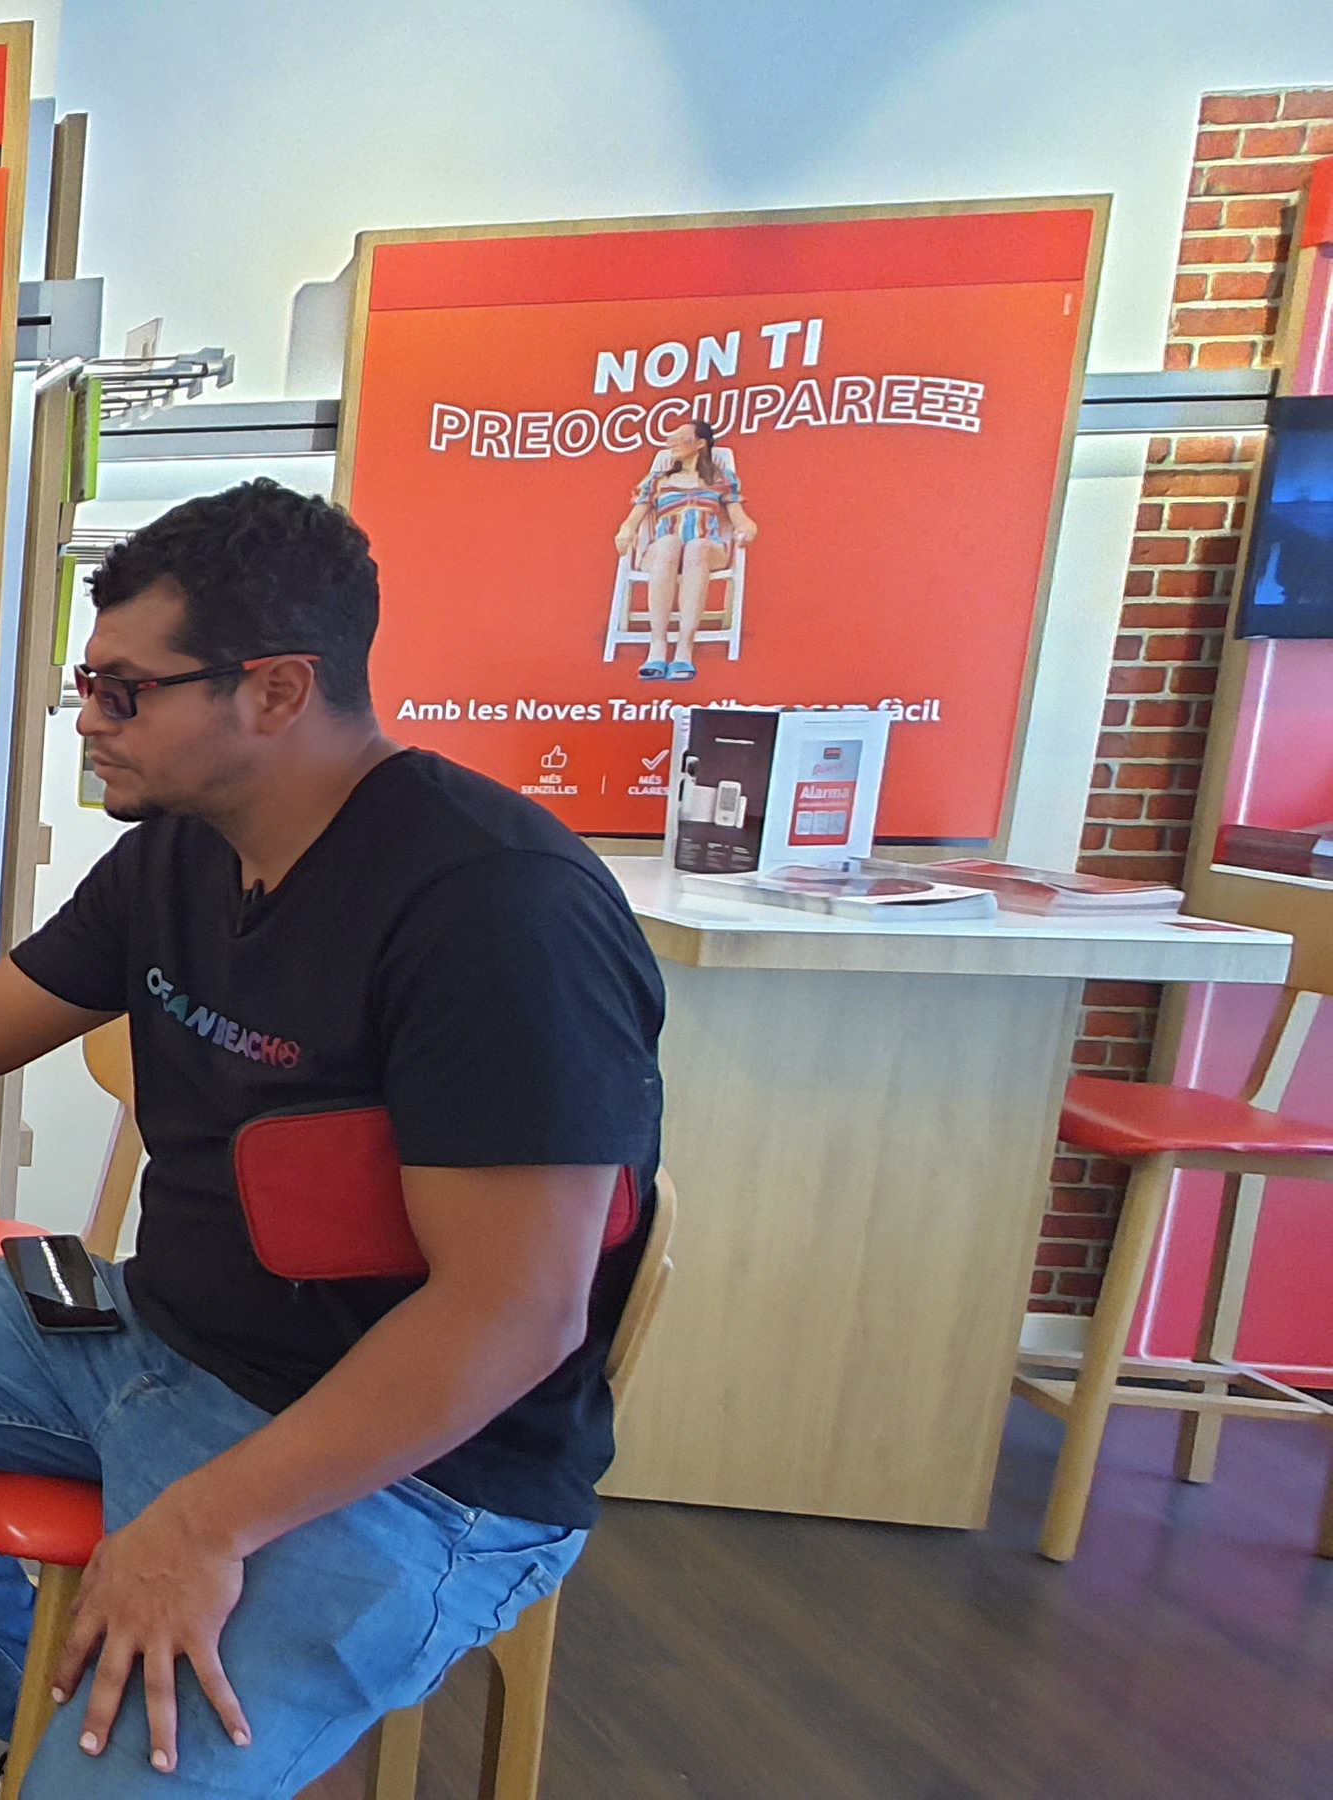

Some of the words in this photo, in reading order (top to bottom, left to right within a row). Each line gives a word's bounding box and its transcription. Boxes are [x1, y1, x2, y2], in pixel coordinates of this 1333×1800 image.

[593, 330, 741, 395] NON
[759, 318, 823, 370] TI
[396, 698, 461, 721] Amb
[467, 698, 509, 721] les
[514, 698, 602, 722] Noves
[608, 698, 687, 721] Tarif
[538, 773, 562, 785] MÉS
[637, 774, 663, 785] MÉS
[520, 785, 578, 795] SENZILLES
[799, 784, 850, 799] Alarma
